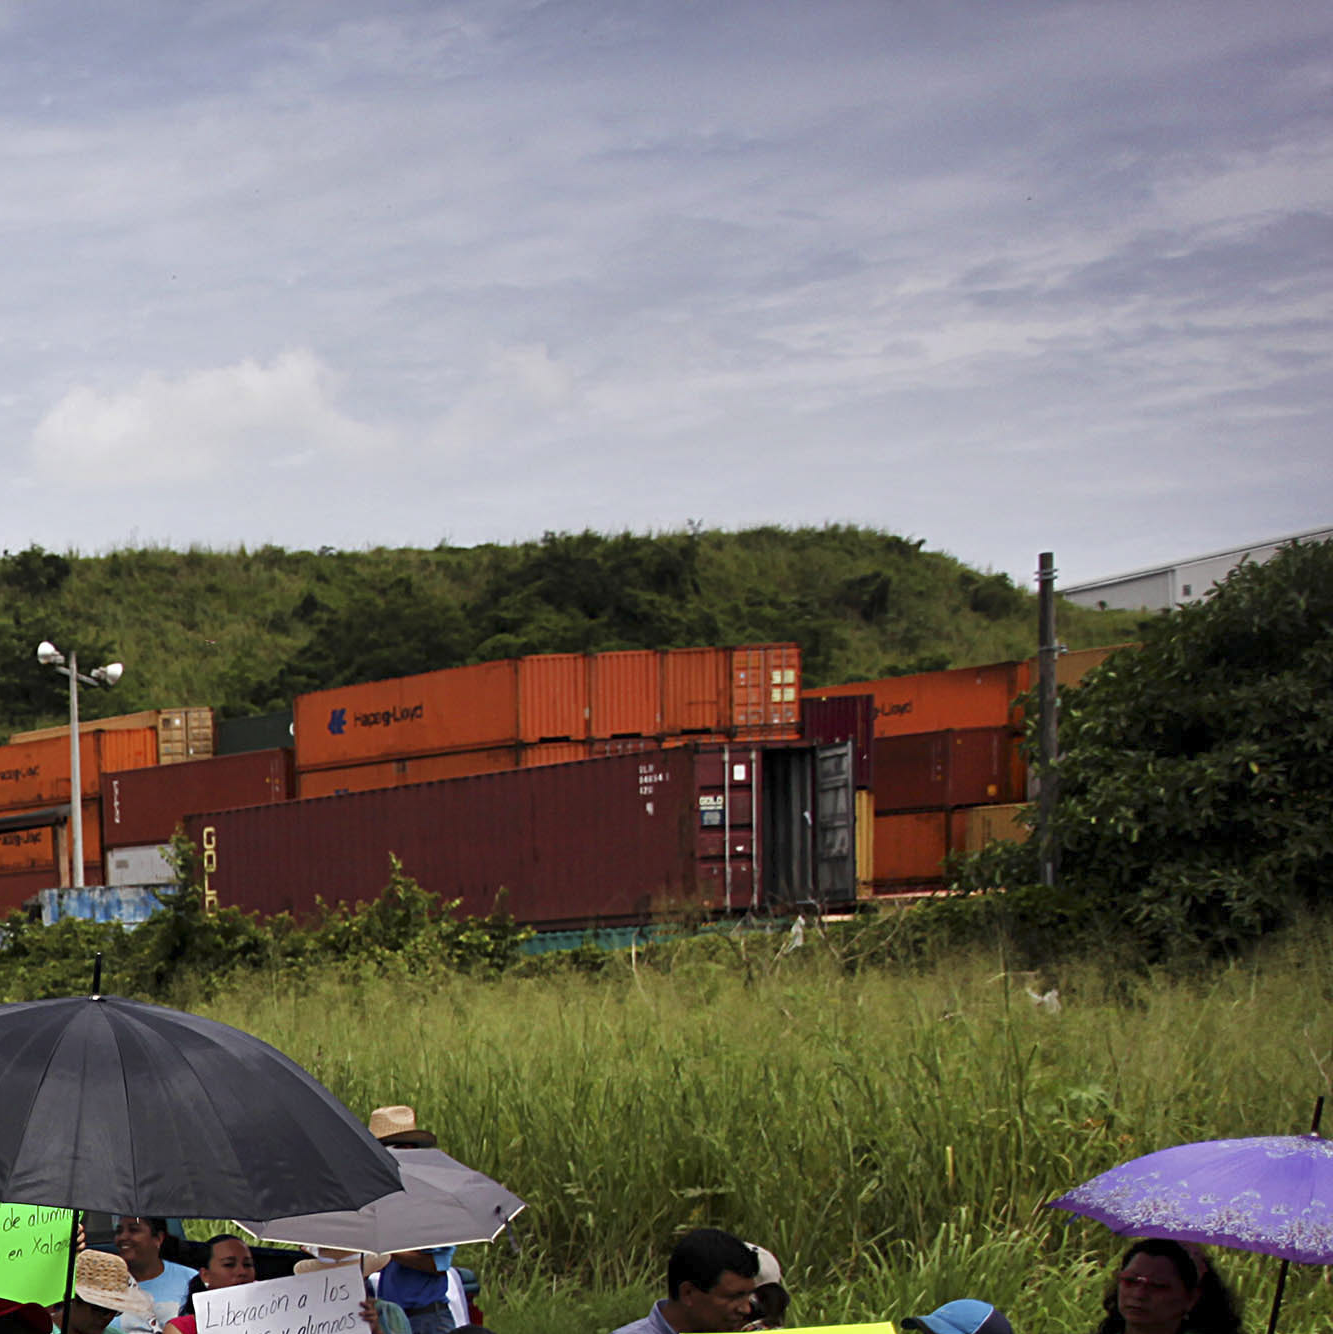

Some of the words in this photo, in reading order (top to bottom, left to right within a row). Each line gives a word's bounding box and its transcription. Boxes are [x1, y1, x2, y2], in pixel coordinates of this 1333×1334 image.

[3, 1208, 21, 1232] de
[8, 1248, 23, 1261] en
[297, 1294, 307, 1308] a
[323, 1276, 350, 1303] los
